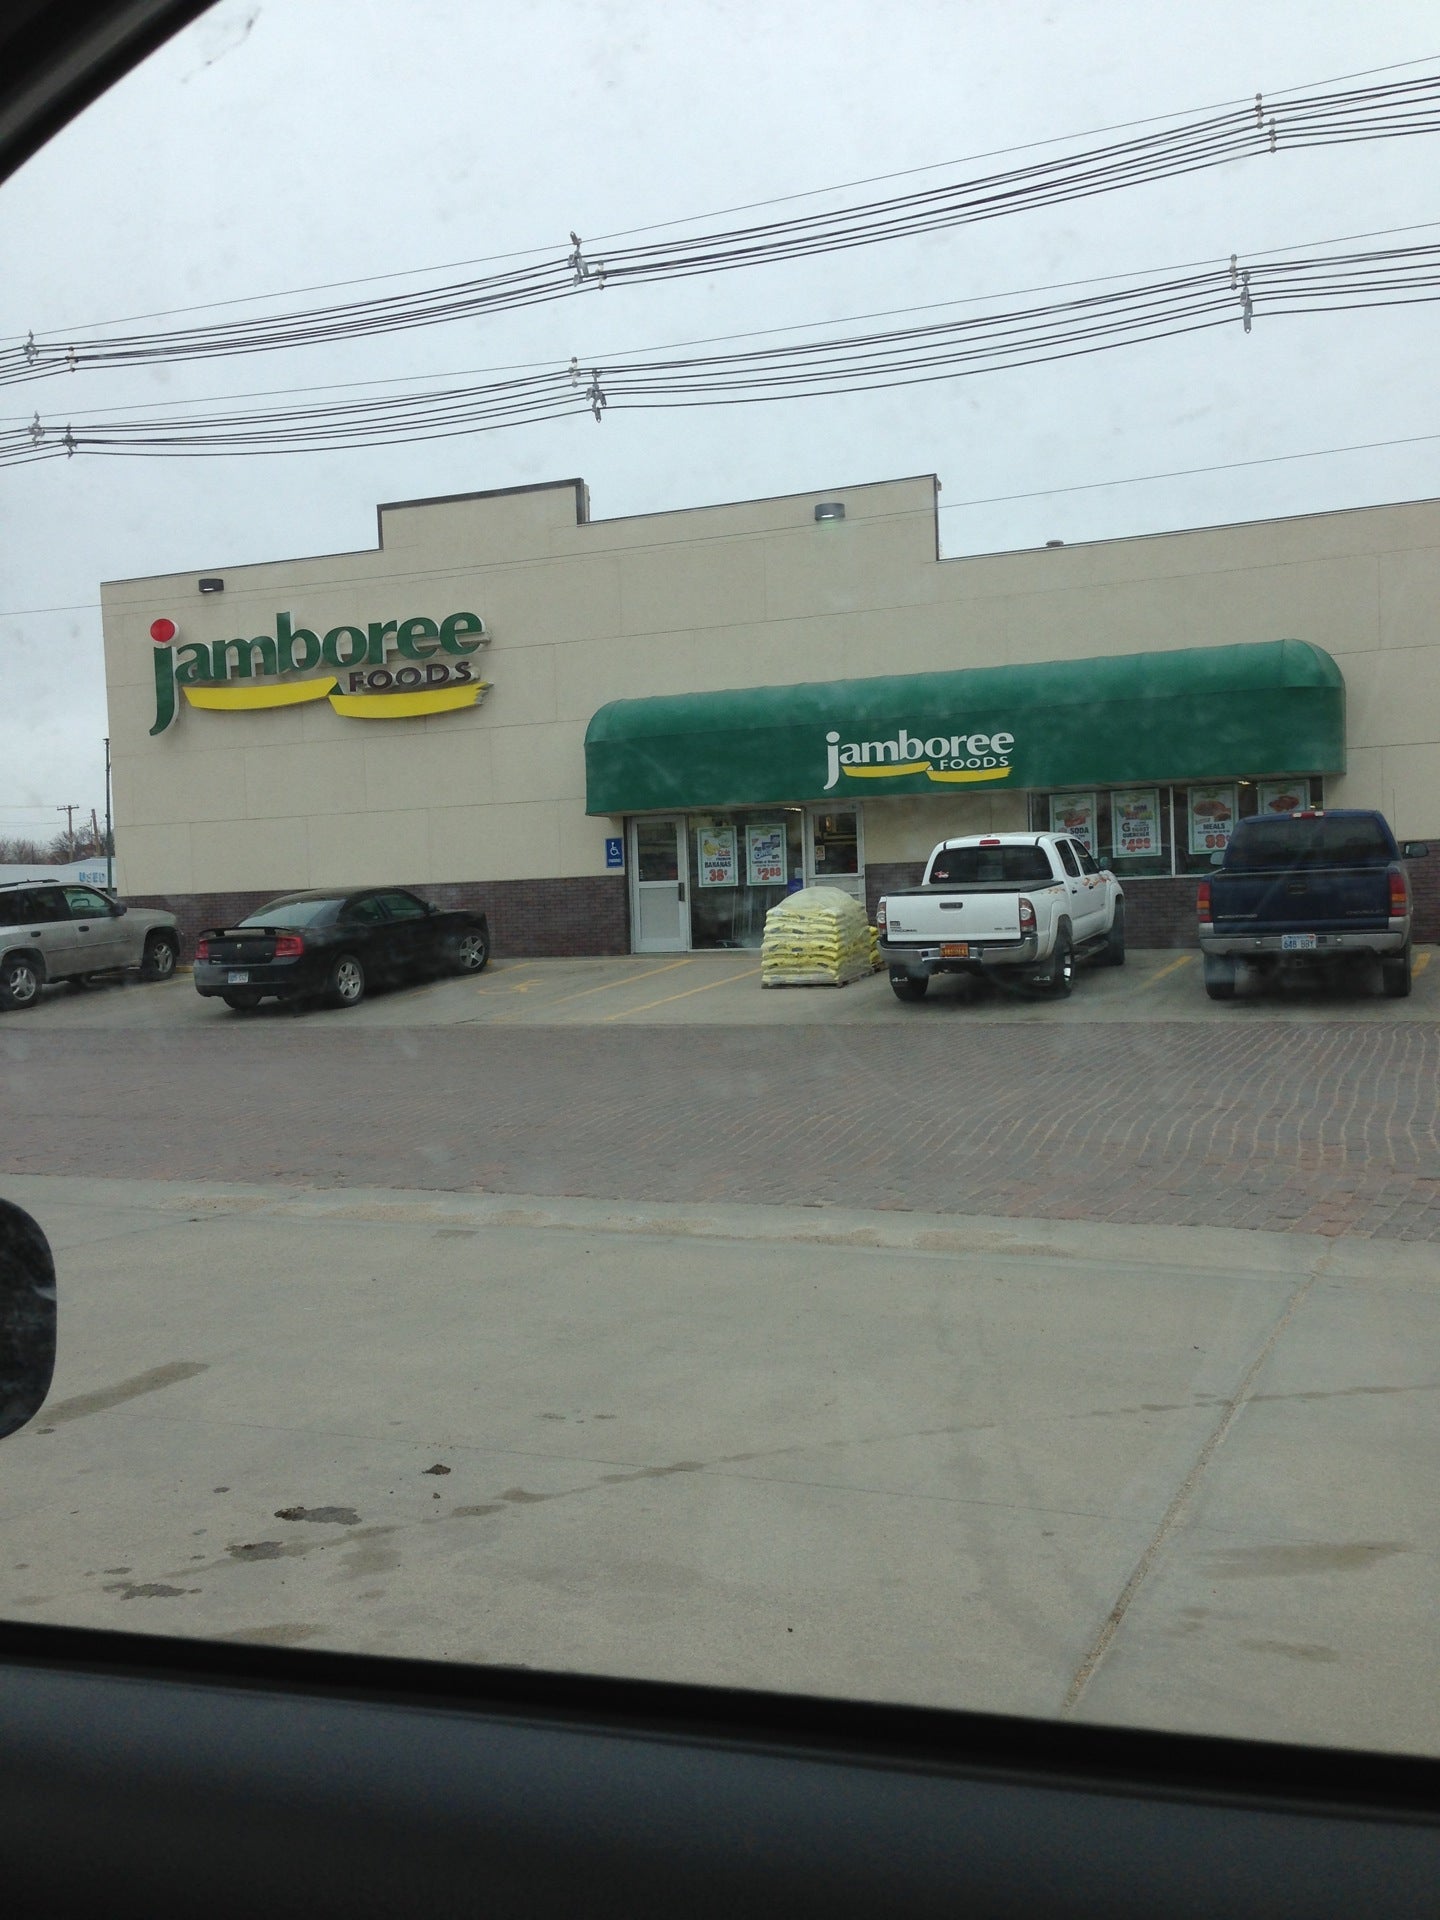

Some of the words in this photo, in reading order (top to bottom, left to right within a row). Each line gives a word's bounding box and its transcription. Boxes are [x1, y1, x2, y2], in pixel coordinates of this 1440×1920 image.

[149, 611, 487, 736] jamboree
[349, 661, 473, 693] FOODS
[823, 729, 1015, 790] jamboree
[939, 756, 1009, 771] FOODS
[1070, 827, 1089, 835] SODA
[704, 861, 732, 869] BANANAS
[79, 871, 105, 883] USED
